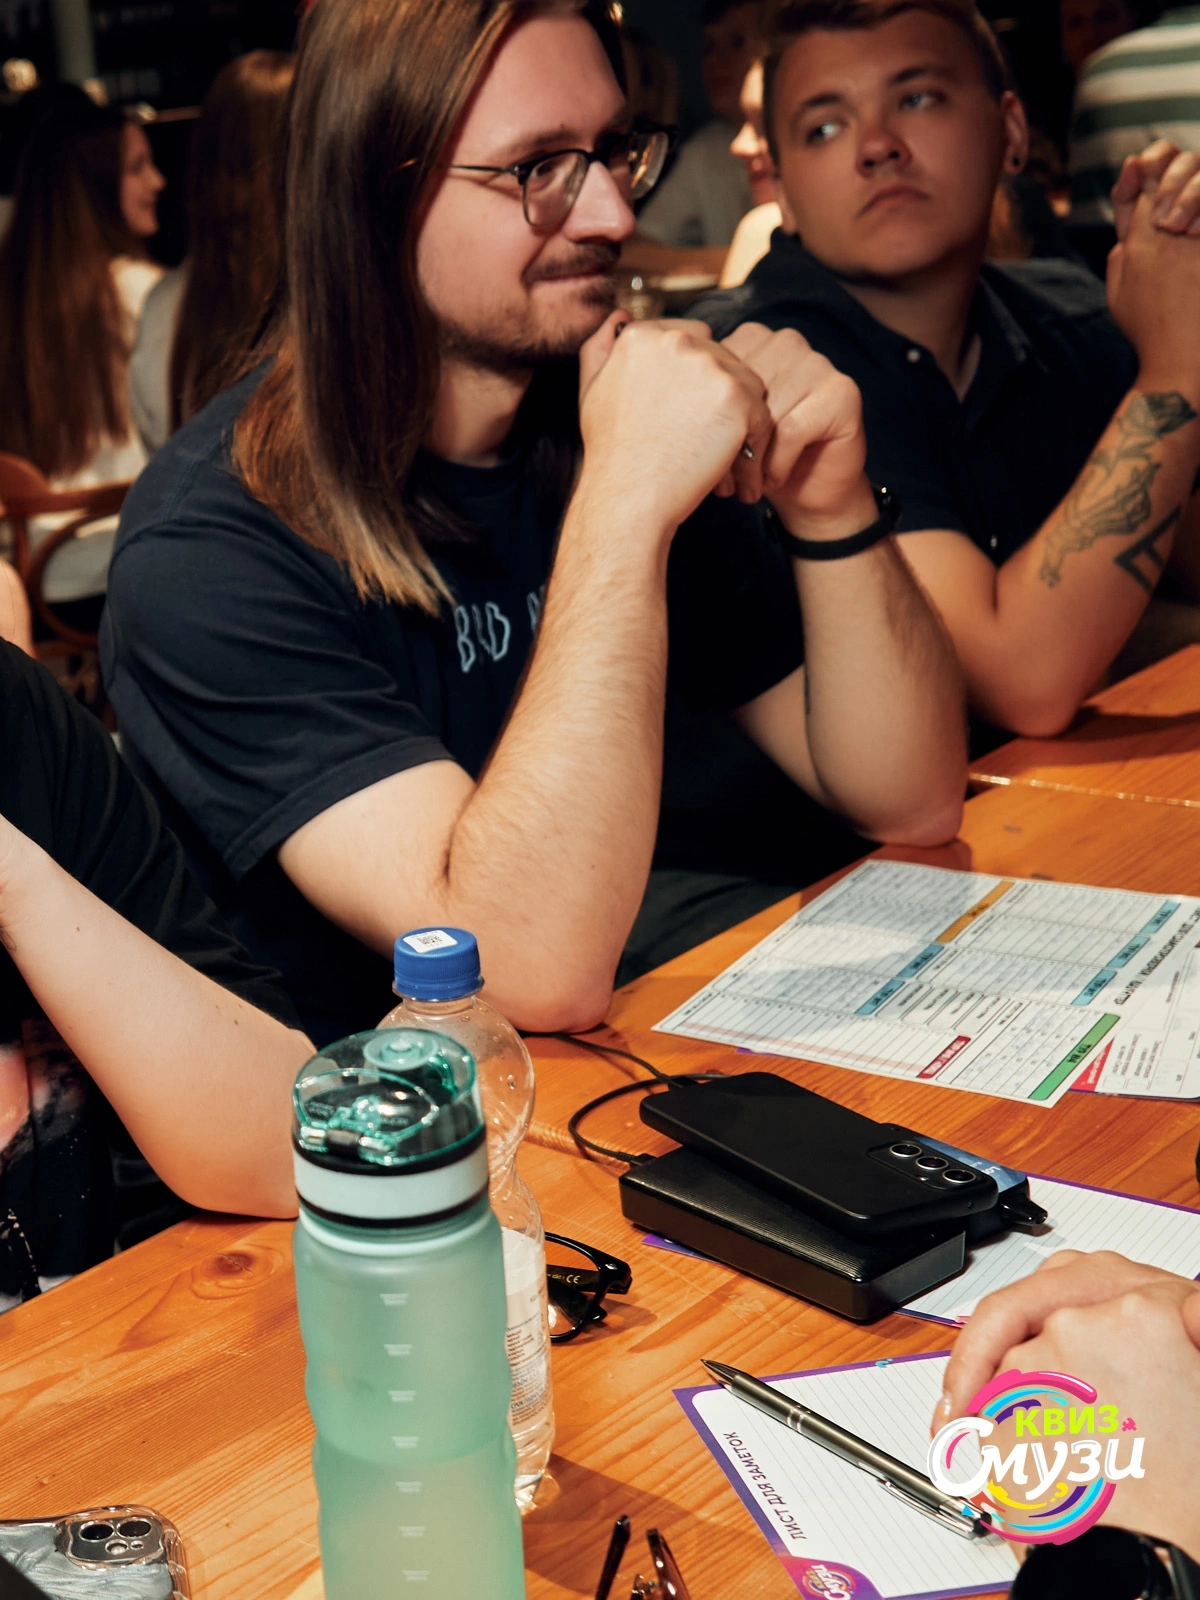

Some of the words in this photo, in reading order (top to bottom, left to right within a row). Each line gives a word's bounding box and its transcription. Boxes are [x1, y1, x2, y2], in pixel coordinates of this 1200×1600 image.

[723, 1431, 767, 1480] ЗАМЕТОК
[757, 1482, 787, 1505] ДЛЯ
[774, 1508, 808, 1540] ЛИСТ
